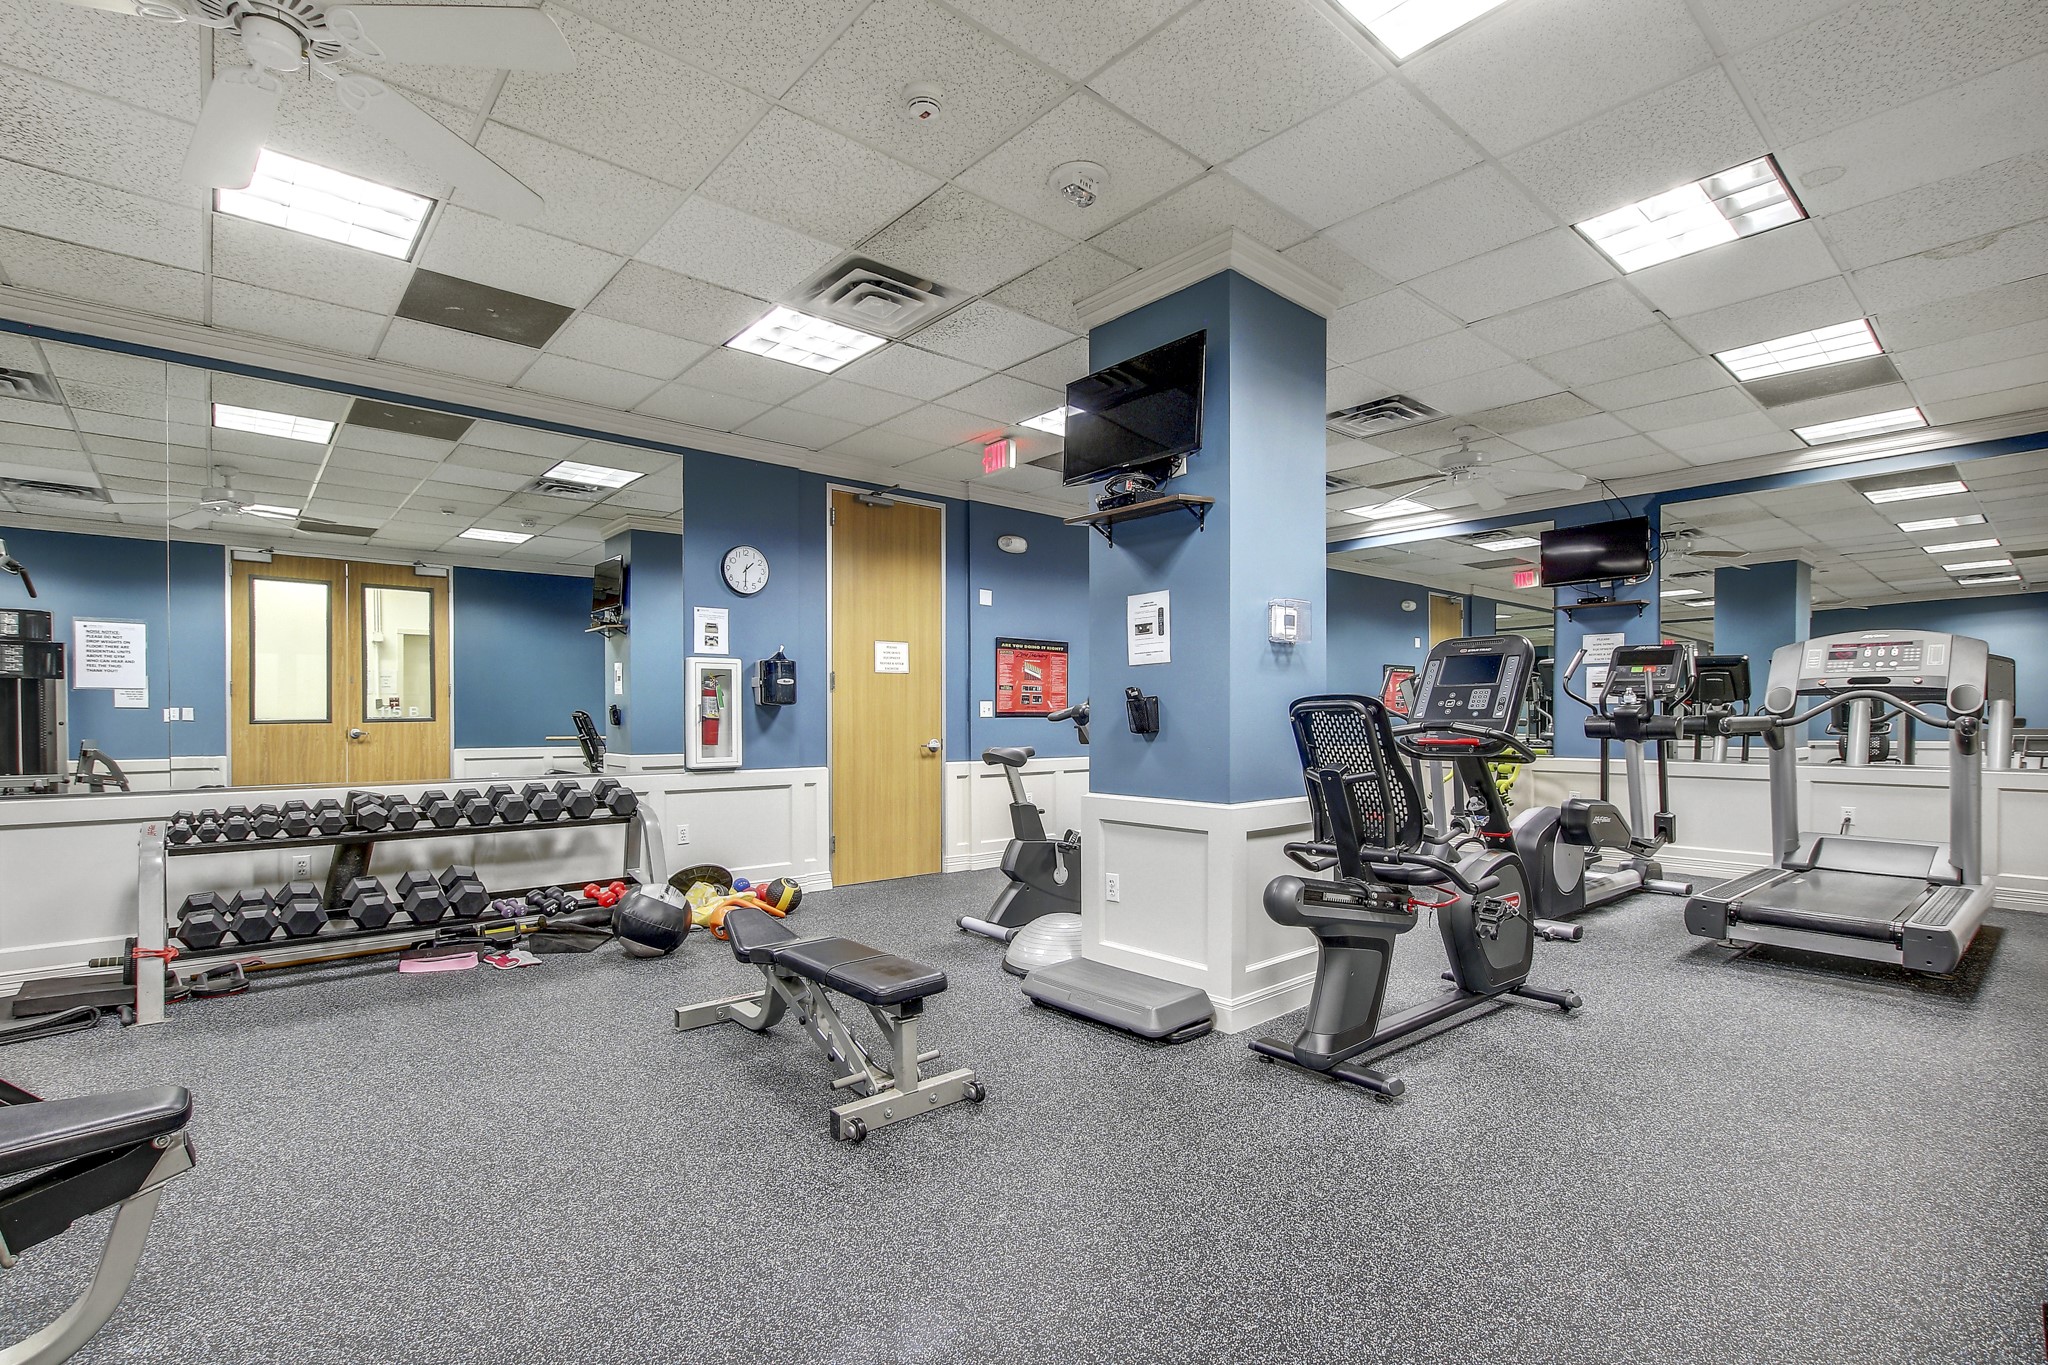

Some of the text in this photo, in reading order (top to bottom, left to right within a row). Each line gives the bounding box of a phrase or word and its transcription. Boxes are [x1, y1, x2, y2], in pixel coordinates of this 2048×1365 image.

[984, 440, 1007, 473] EXIT
[378, 706, 420, 717] 115 B
